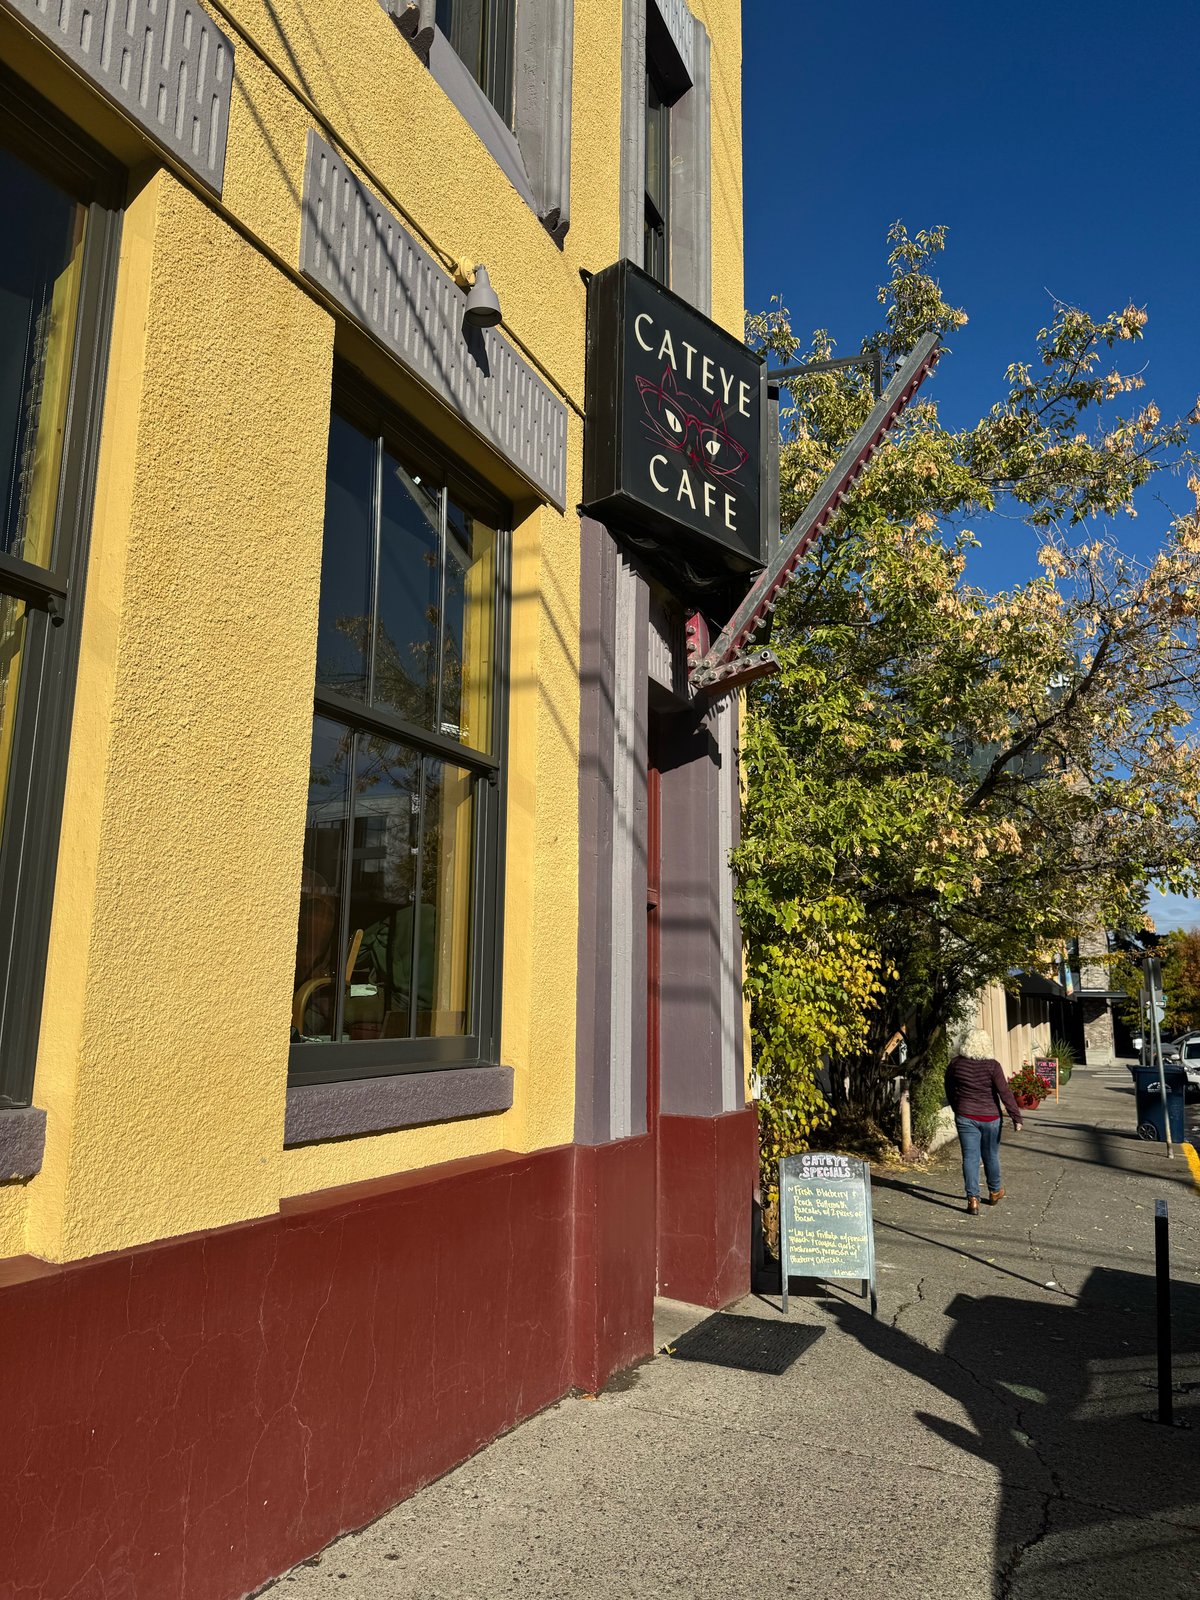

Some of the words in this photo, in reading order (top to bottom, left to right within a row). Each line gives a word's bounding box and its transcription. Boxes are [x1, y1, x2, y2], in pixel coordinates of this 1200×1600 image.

[634, 313, 751, 418] CATEYE
[649, 454, 737, 532] CAFE
[802, 1154, 848, 1167] CATEYE
[803, 1167, 851, 1178] SPECIALS
